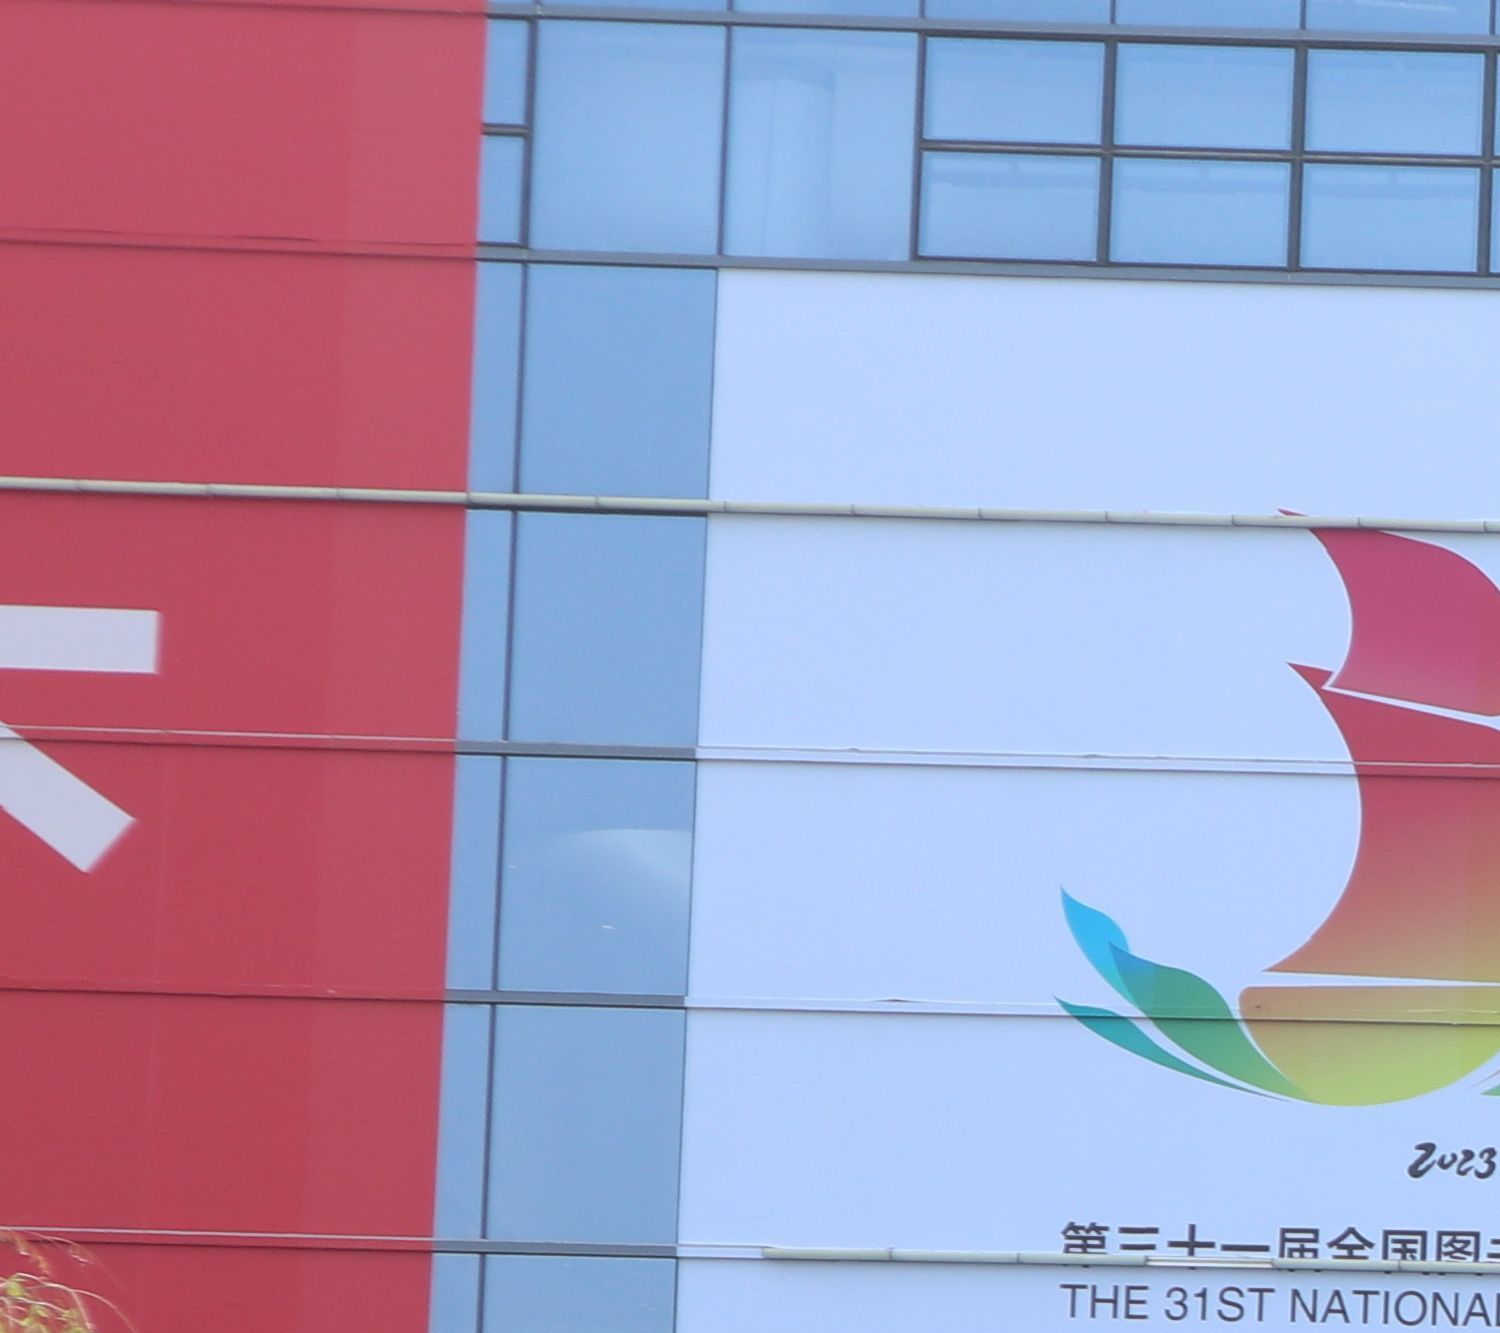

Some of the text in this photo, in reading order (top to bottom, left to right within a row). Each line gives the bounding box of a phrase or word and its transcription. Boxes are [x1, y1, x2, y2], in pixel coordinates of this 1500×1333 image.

[1408, 1140, 1498, 1179] 2023
[1060, 1283, 1150, 1321] THE
[1163, 1285, 1275, 1324] 31ST
